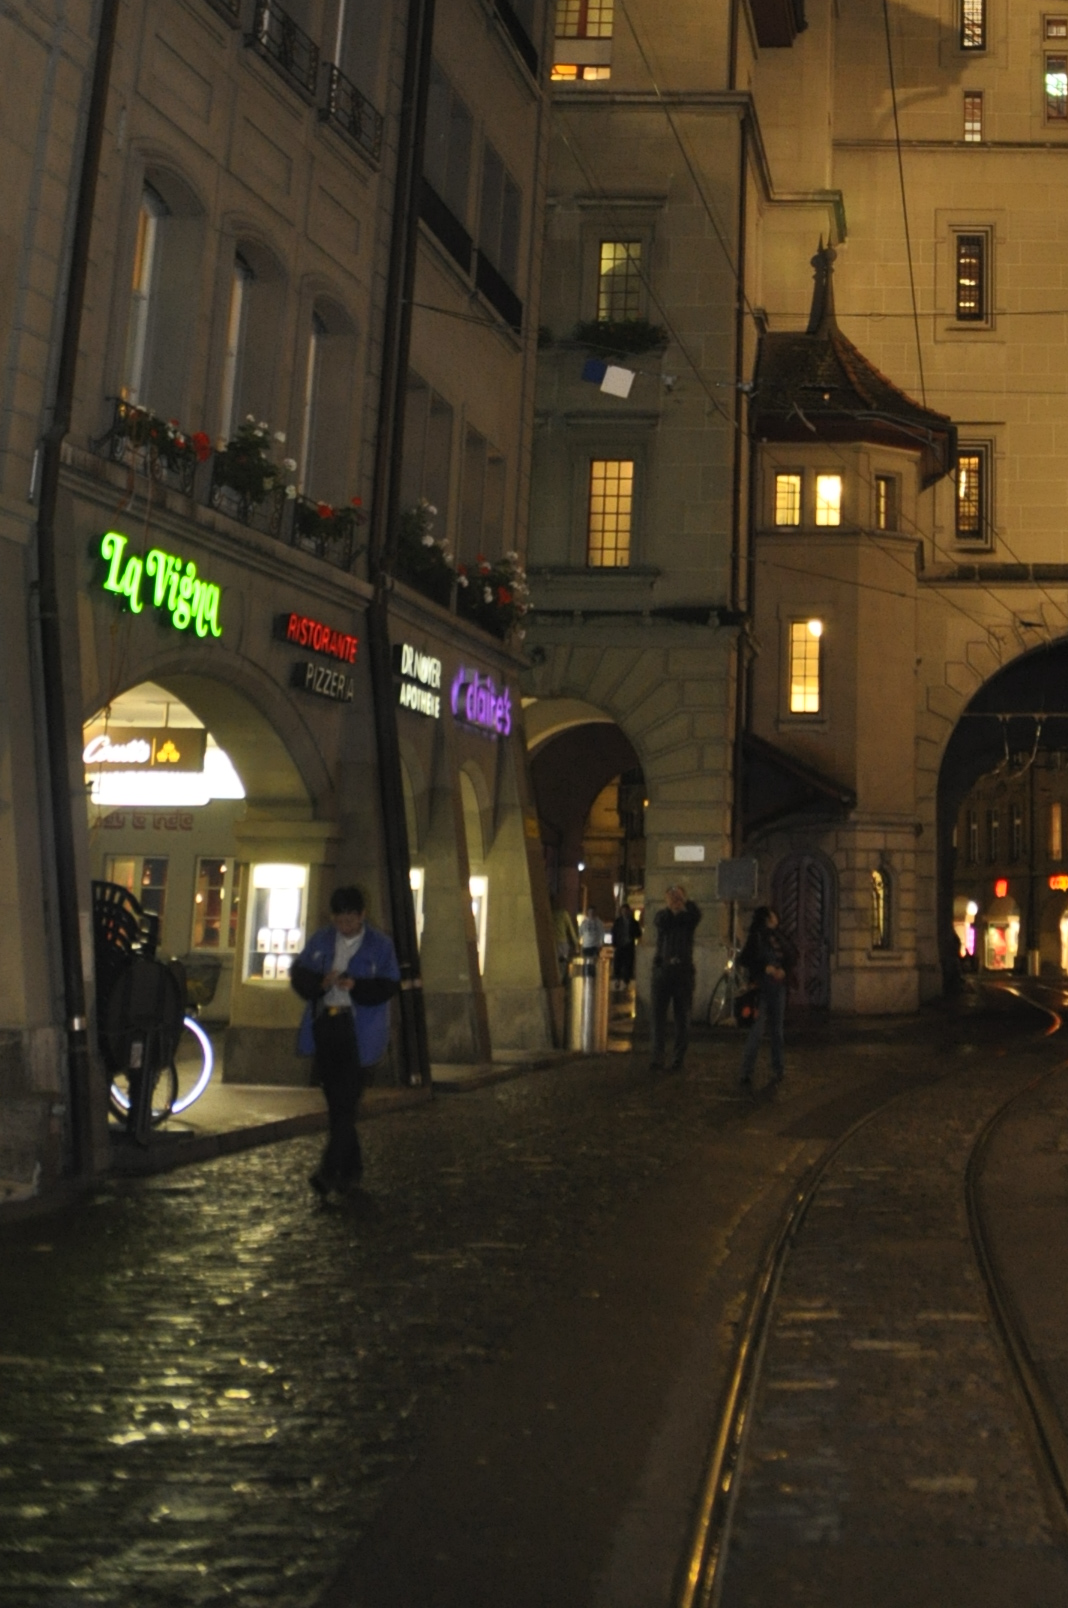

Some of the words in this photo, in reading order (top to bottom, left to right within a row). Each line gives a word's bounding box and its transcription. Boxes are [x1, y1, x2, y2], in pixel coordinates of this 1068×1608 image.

[101, 532, 143, 613] La
[146, 549, 222, 637] Vigna
[286, 612, 359, 664] RISTORANTE
[305, 662, 355, 702] PIZZERIA
[399, 683, 441, 720] APOTHEKE
[463, 669, 512, 736] claire's
